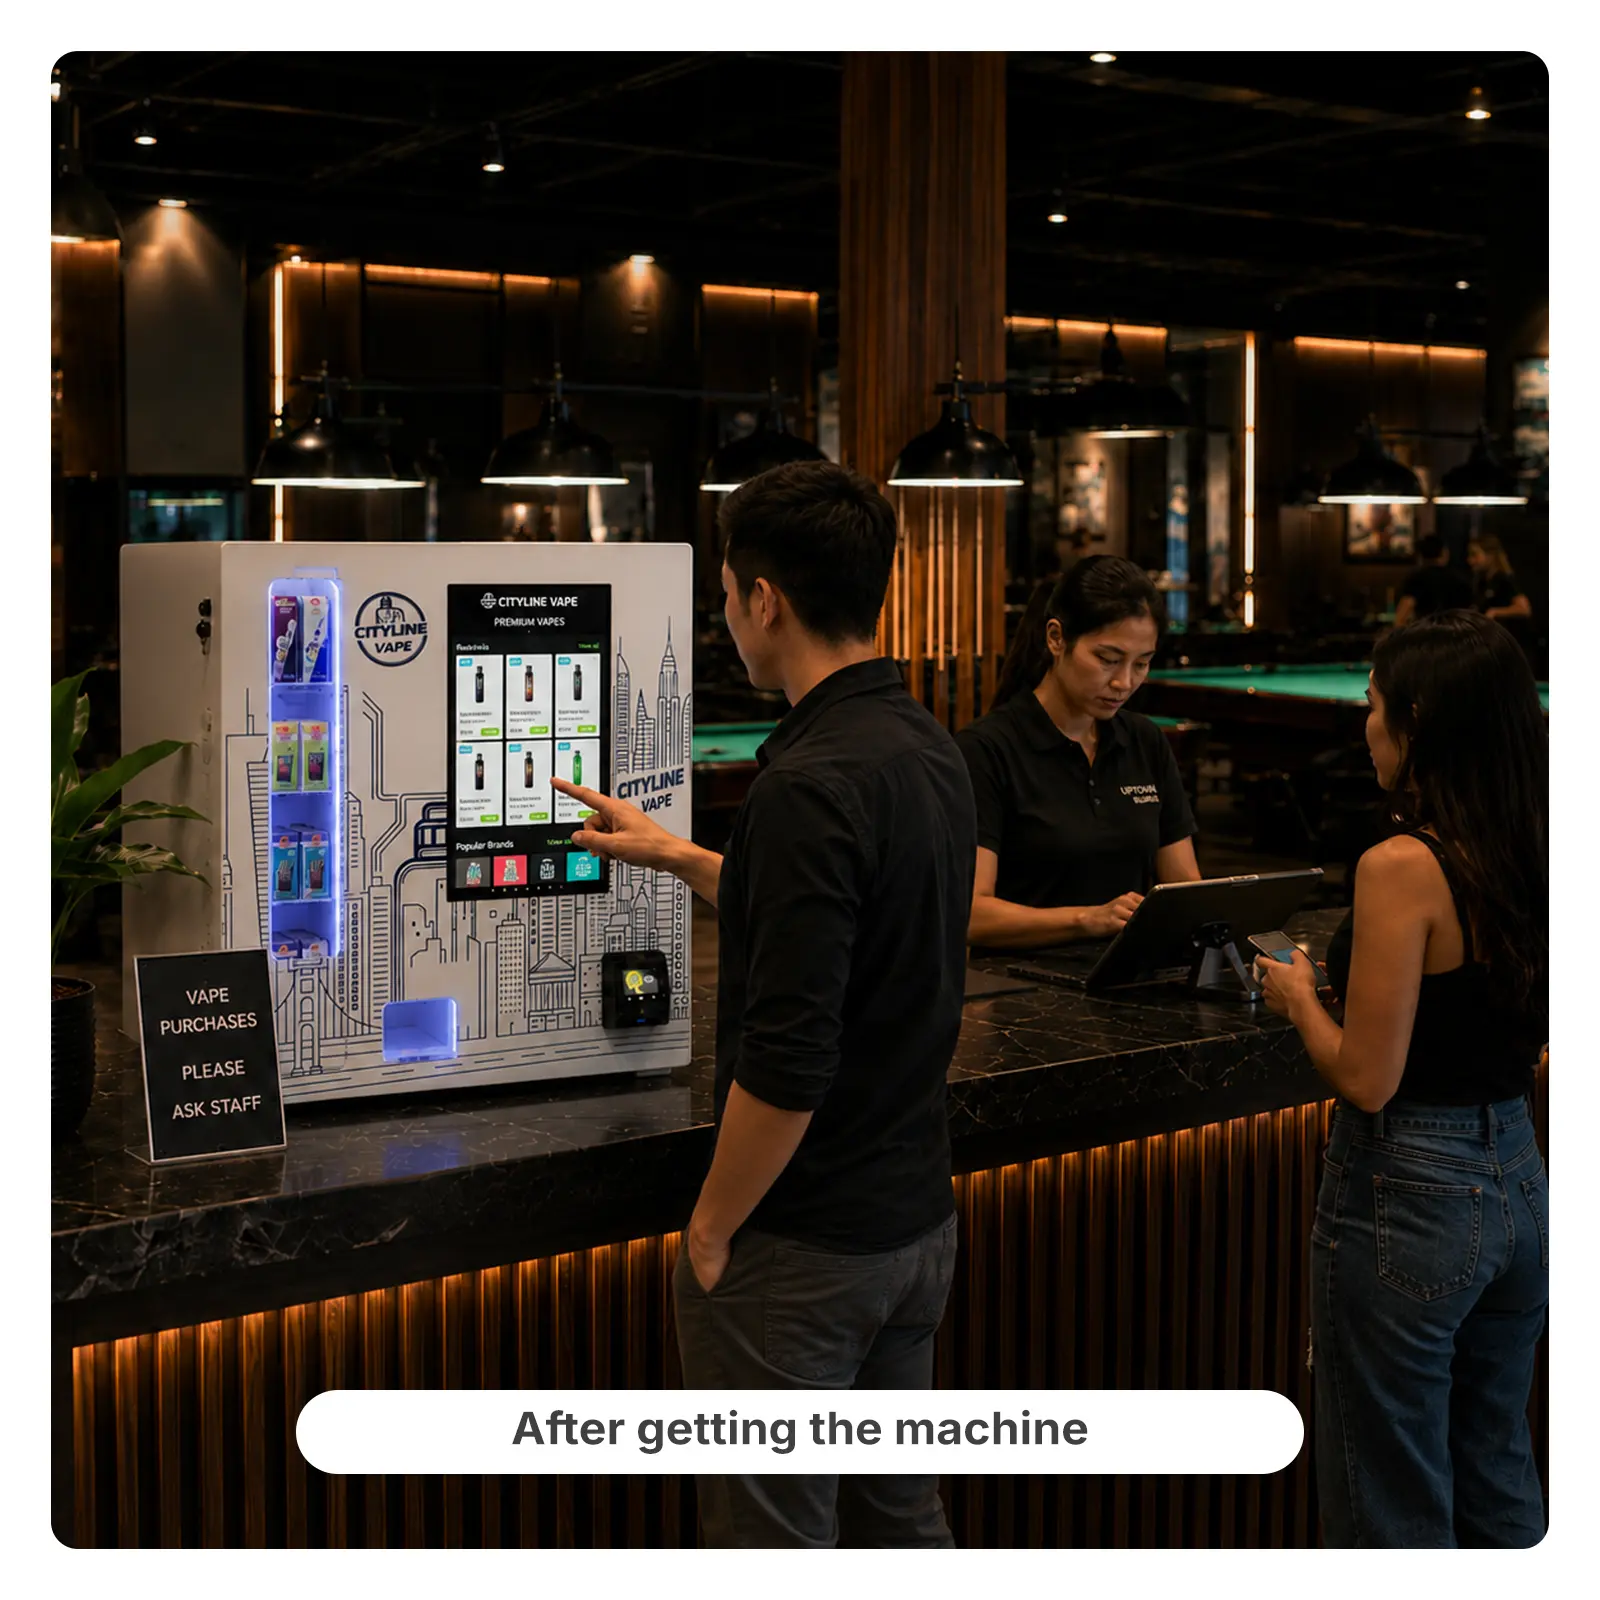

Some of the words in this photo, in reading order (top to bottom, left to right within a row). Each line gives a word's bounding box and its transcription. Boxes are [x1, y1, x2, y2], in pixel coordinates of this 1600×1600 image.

[498, 596, 548, 608] CITYLINE
[549, 596, 578, 608] VAPE
[354, 622, 428, 639] CITYLINE
[494, 617, 536, 628] PREMIUM
[536, 616, 566, 627] VAPES
[374, 640, 413, 654] VAPE
[616, 768, 685, 800] CITYLINE
[641, 793, 672, 813] VAPE
[185, 986, 230, 1006] VAPE
[160, 1012, 258, 1037] PURCHASES
[182, 1059, 246, 1082] PLEASE
[172, 1100, 206, 1120] ASK
[210, 1094, 262, 1116] STAFF
